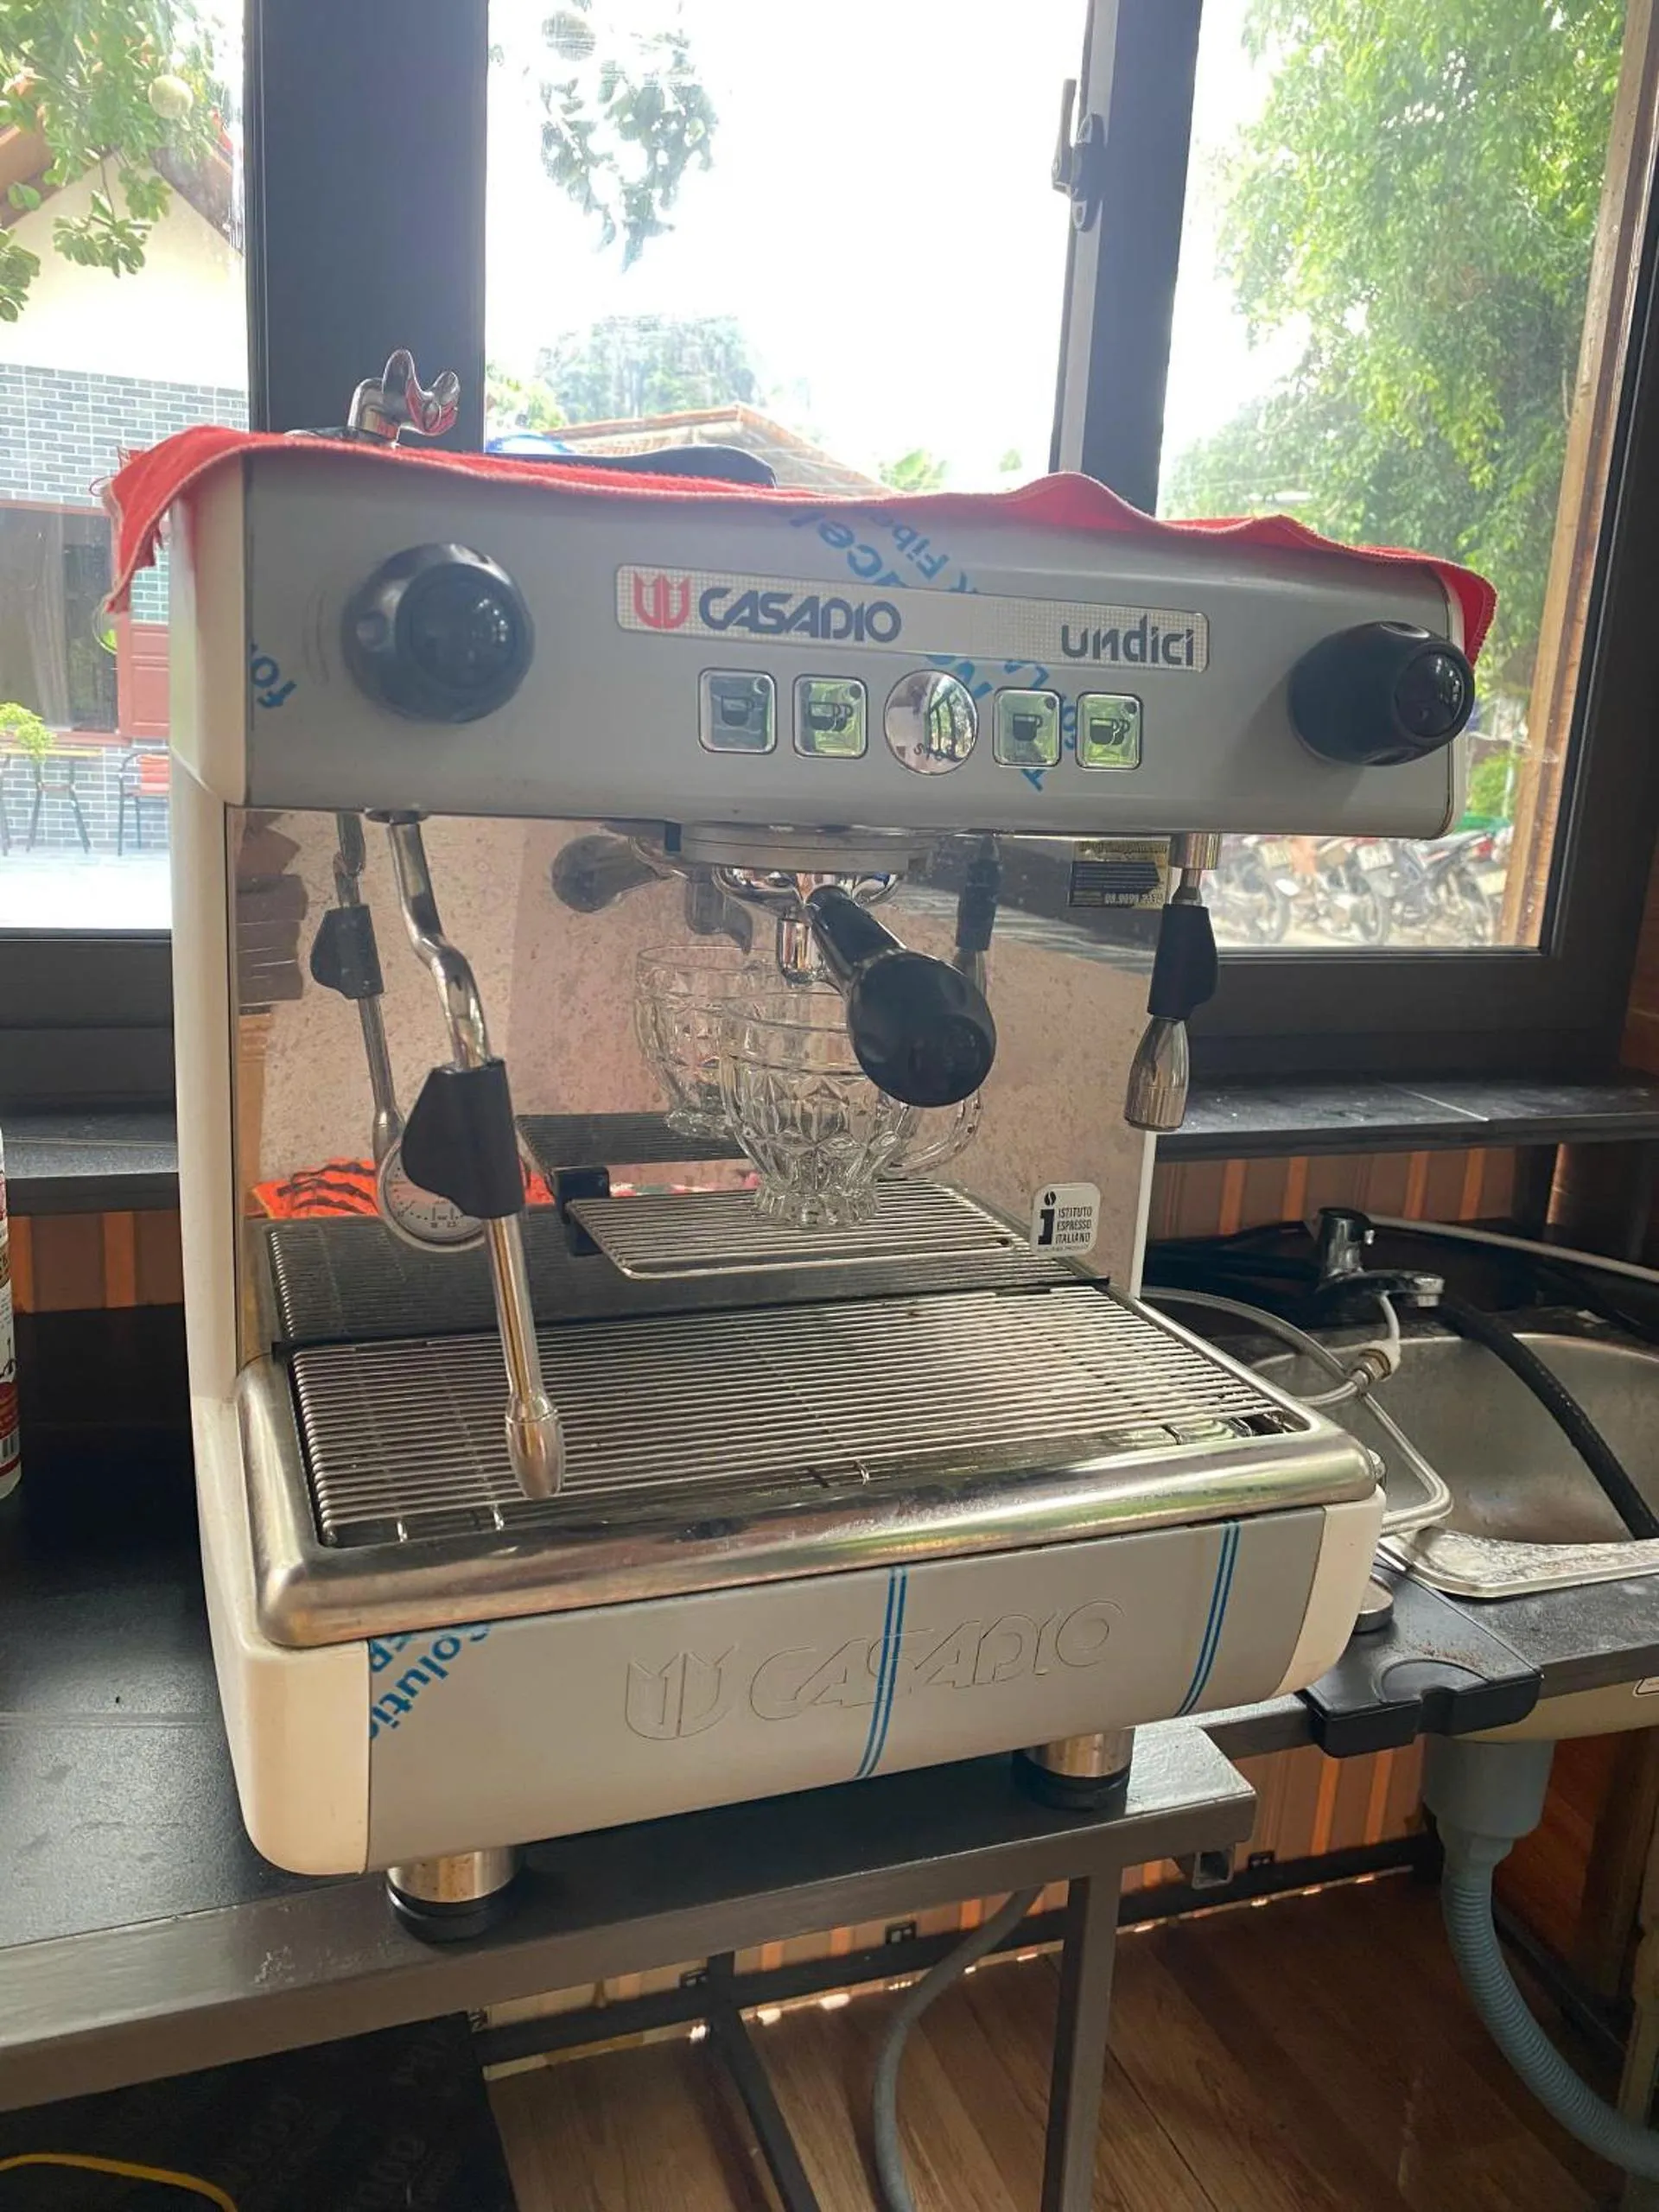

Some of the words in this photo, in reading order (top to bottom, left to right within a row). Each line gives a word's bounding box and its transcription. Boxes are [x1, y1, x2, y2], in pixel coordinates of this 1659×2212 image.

[698, 588, 902, 643] CASADIO
[1061, 613, 1194, 666] undici
[1058, 1206, 1093, 1218] ISTITUTO
[1057, 1219, 1092, 1231] ESPRESSO
[1055, 1232, 1091, 1244] ITALIANO
[749, 1599, 1124, 1720] CASADIO
